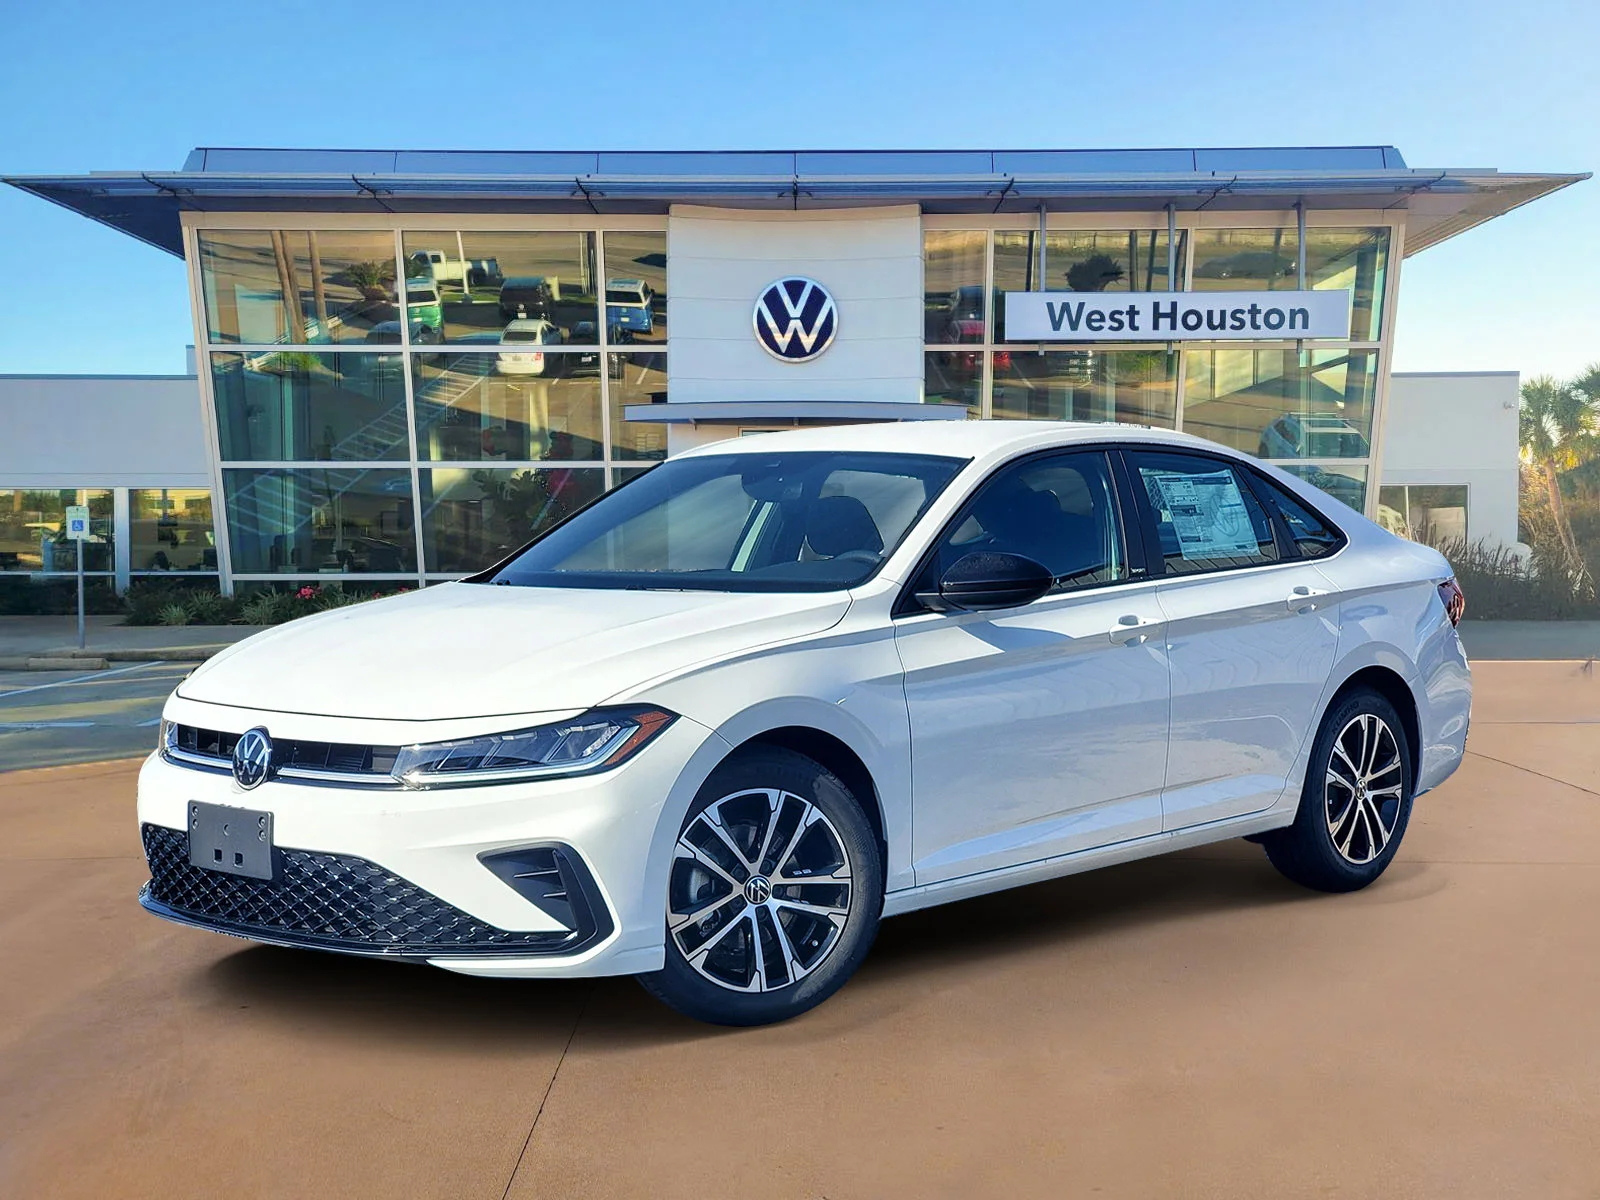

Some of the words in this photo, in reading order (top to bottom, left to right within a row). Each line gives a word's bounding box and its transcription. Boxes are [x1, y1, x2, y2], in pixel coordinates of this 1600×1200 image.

[757, 279, 833, 354] VW
[1046, 301, 1141, 331] West
[1152, 300, 1310, 331] Houston
